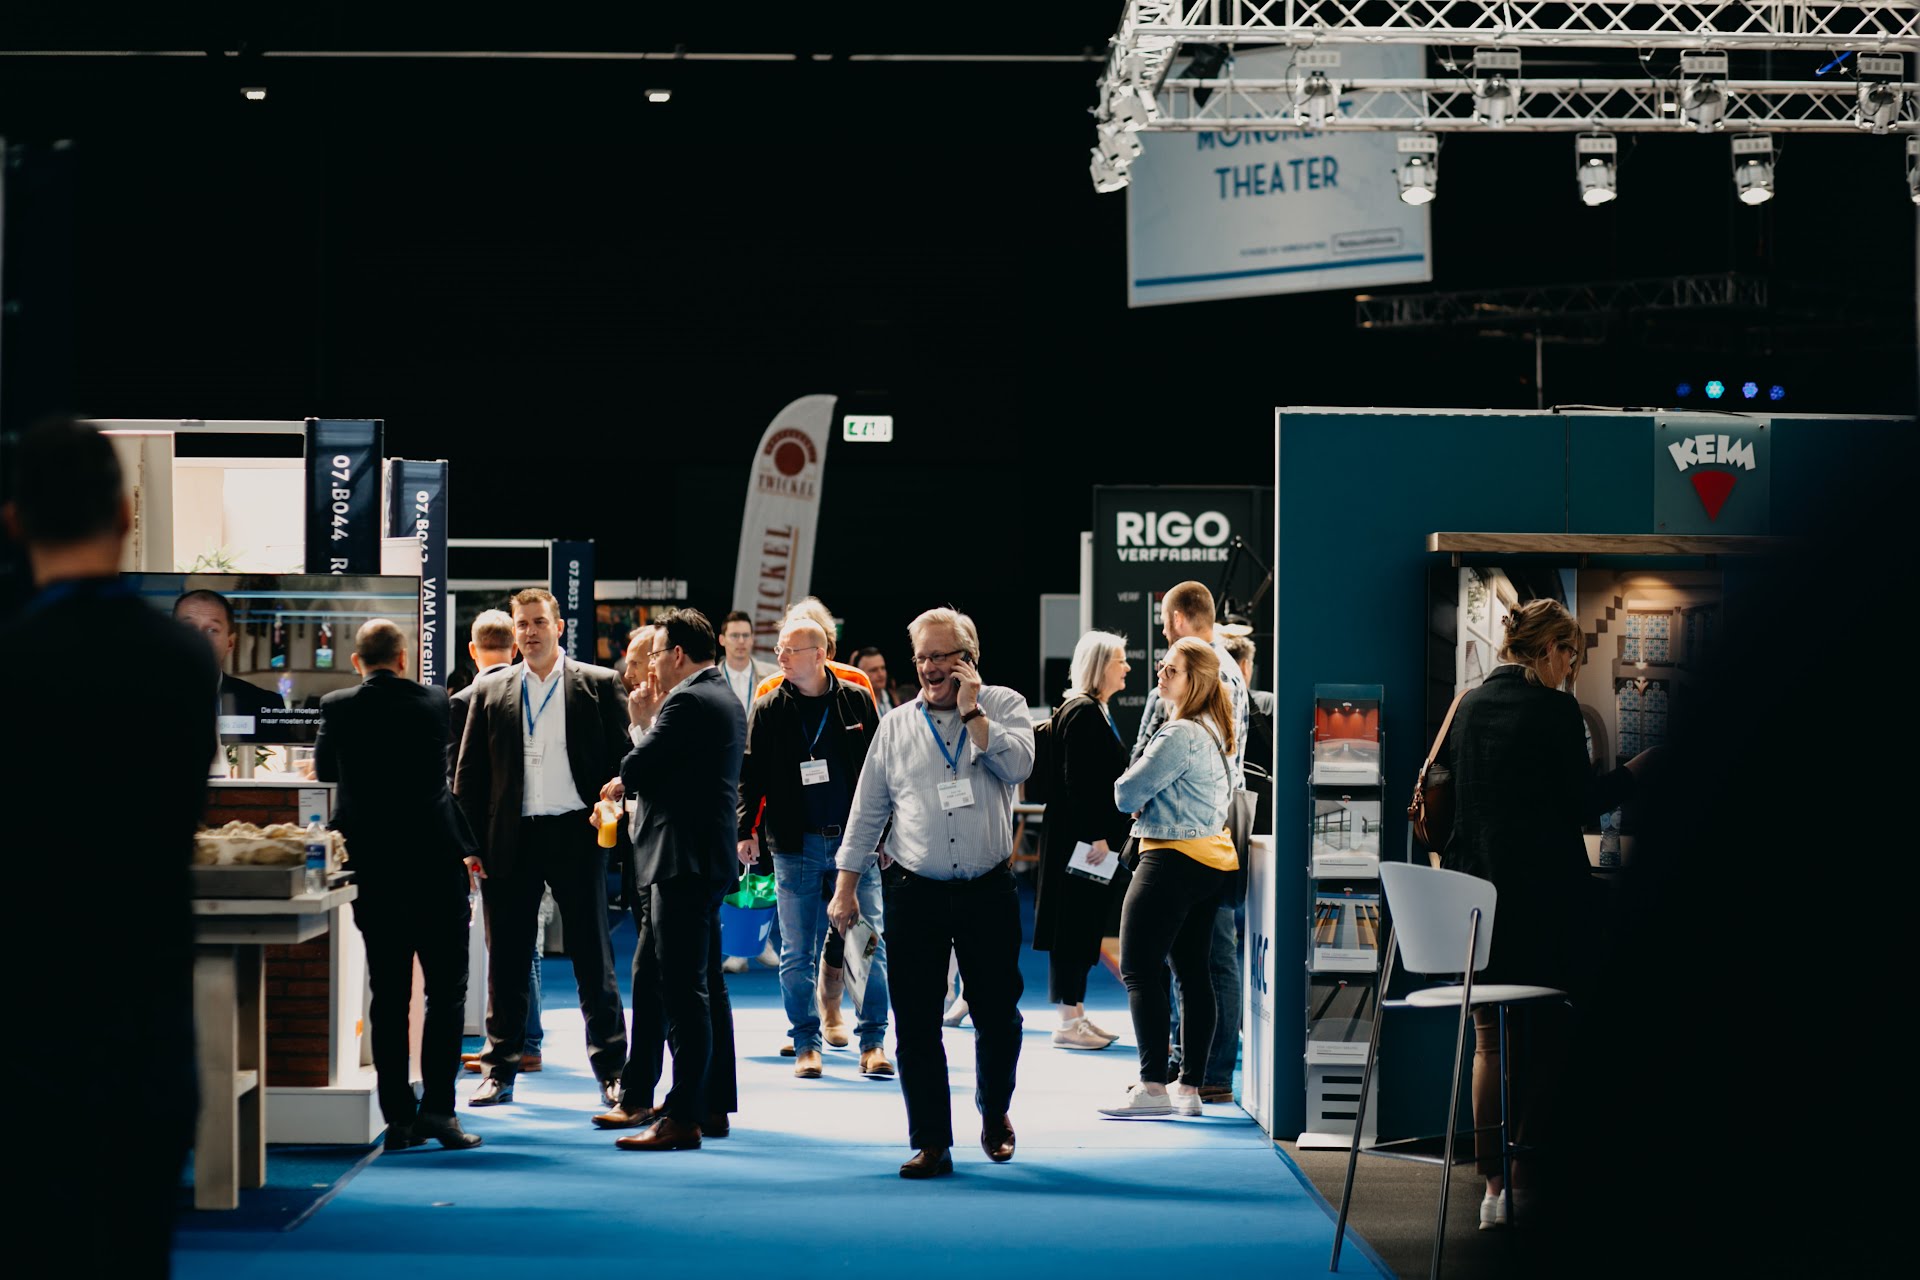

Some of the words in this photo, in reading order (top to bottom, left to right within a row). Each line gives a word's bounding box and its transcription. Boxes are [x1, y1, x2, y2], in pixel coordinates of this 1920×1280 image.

[1215, 155, 1339, 199] THEATER
[1667, 433, 1756, 472] KEIM
[331, 454, 351, 541] 07.B044
[1116, 510, 1231, 547] RIGO
[1117, 548, 1229, 562] VERFFABRIEK
[423, 577, 436, 616] VAM
[567, 560, 580, 611] 07.B032
[1117, 591, 1141, 602] VERF
[1126, 649, 1146, 660] AND
[260, 706, 271, 714] De
